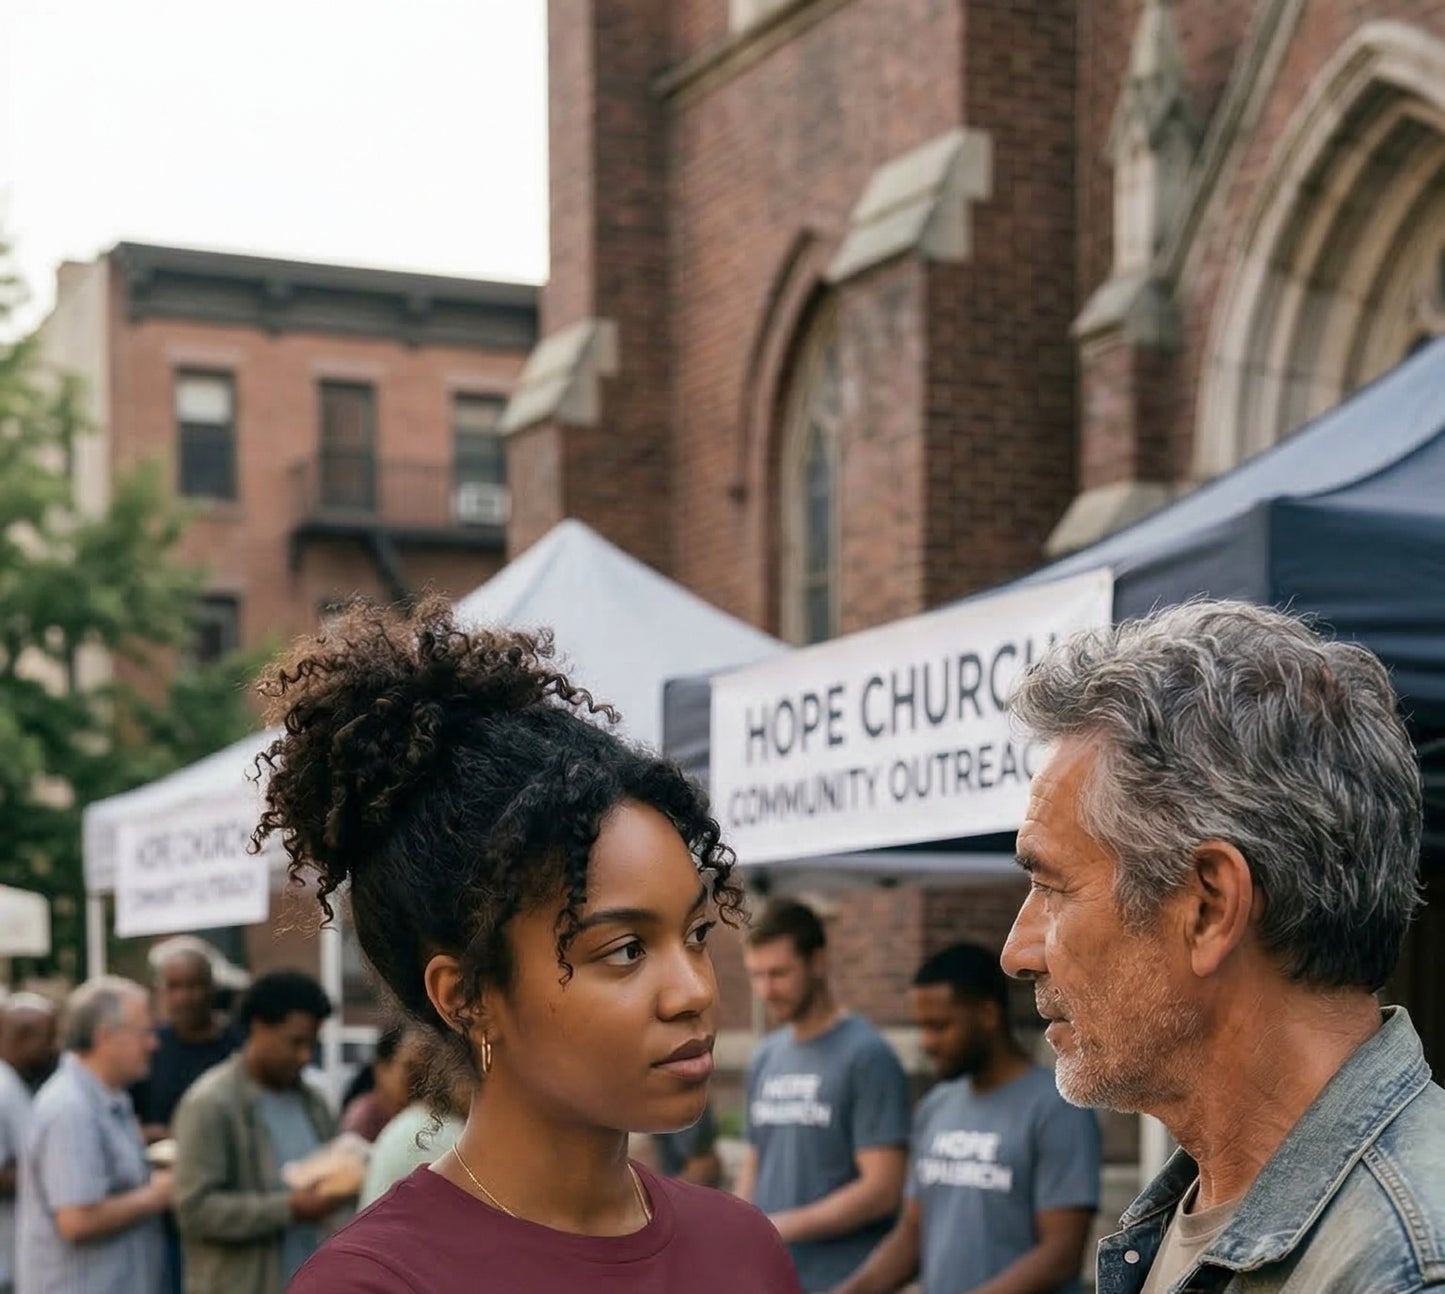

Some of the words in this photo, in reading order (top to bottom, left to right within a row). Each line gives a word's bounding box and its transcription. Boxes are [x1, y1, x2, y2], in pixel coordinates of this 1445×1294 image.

[746, 684, 847, 765] HOPE
[861, 633, 1055, 738] CHURC
[730, 766, 879, 828] COMMUNITY
[889, 740, 1035, 803] OUTREAC
